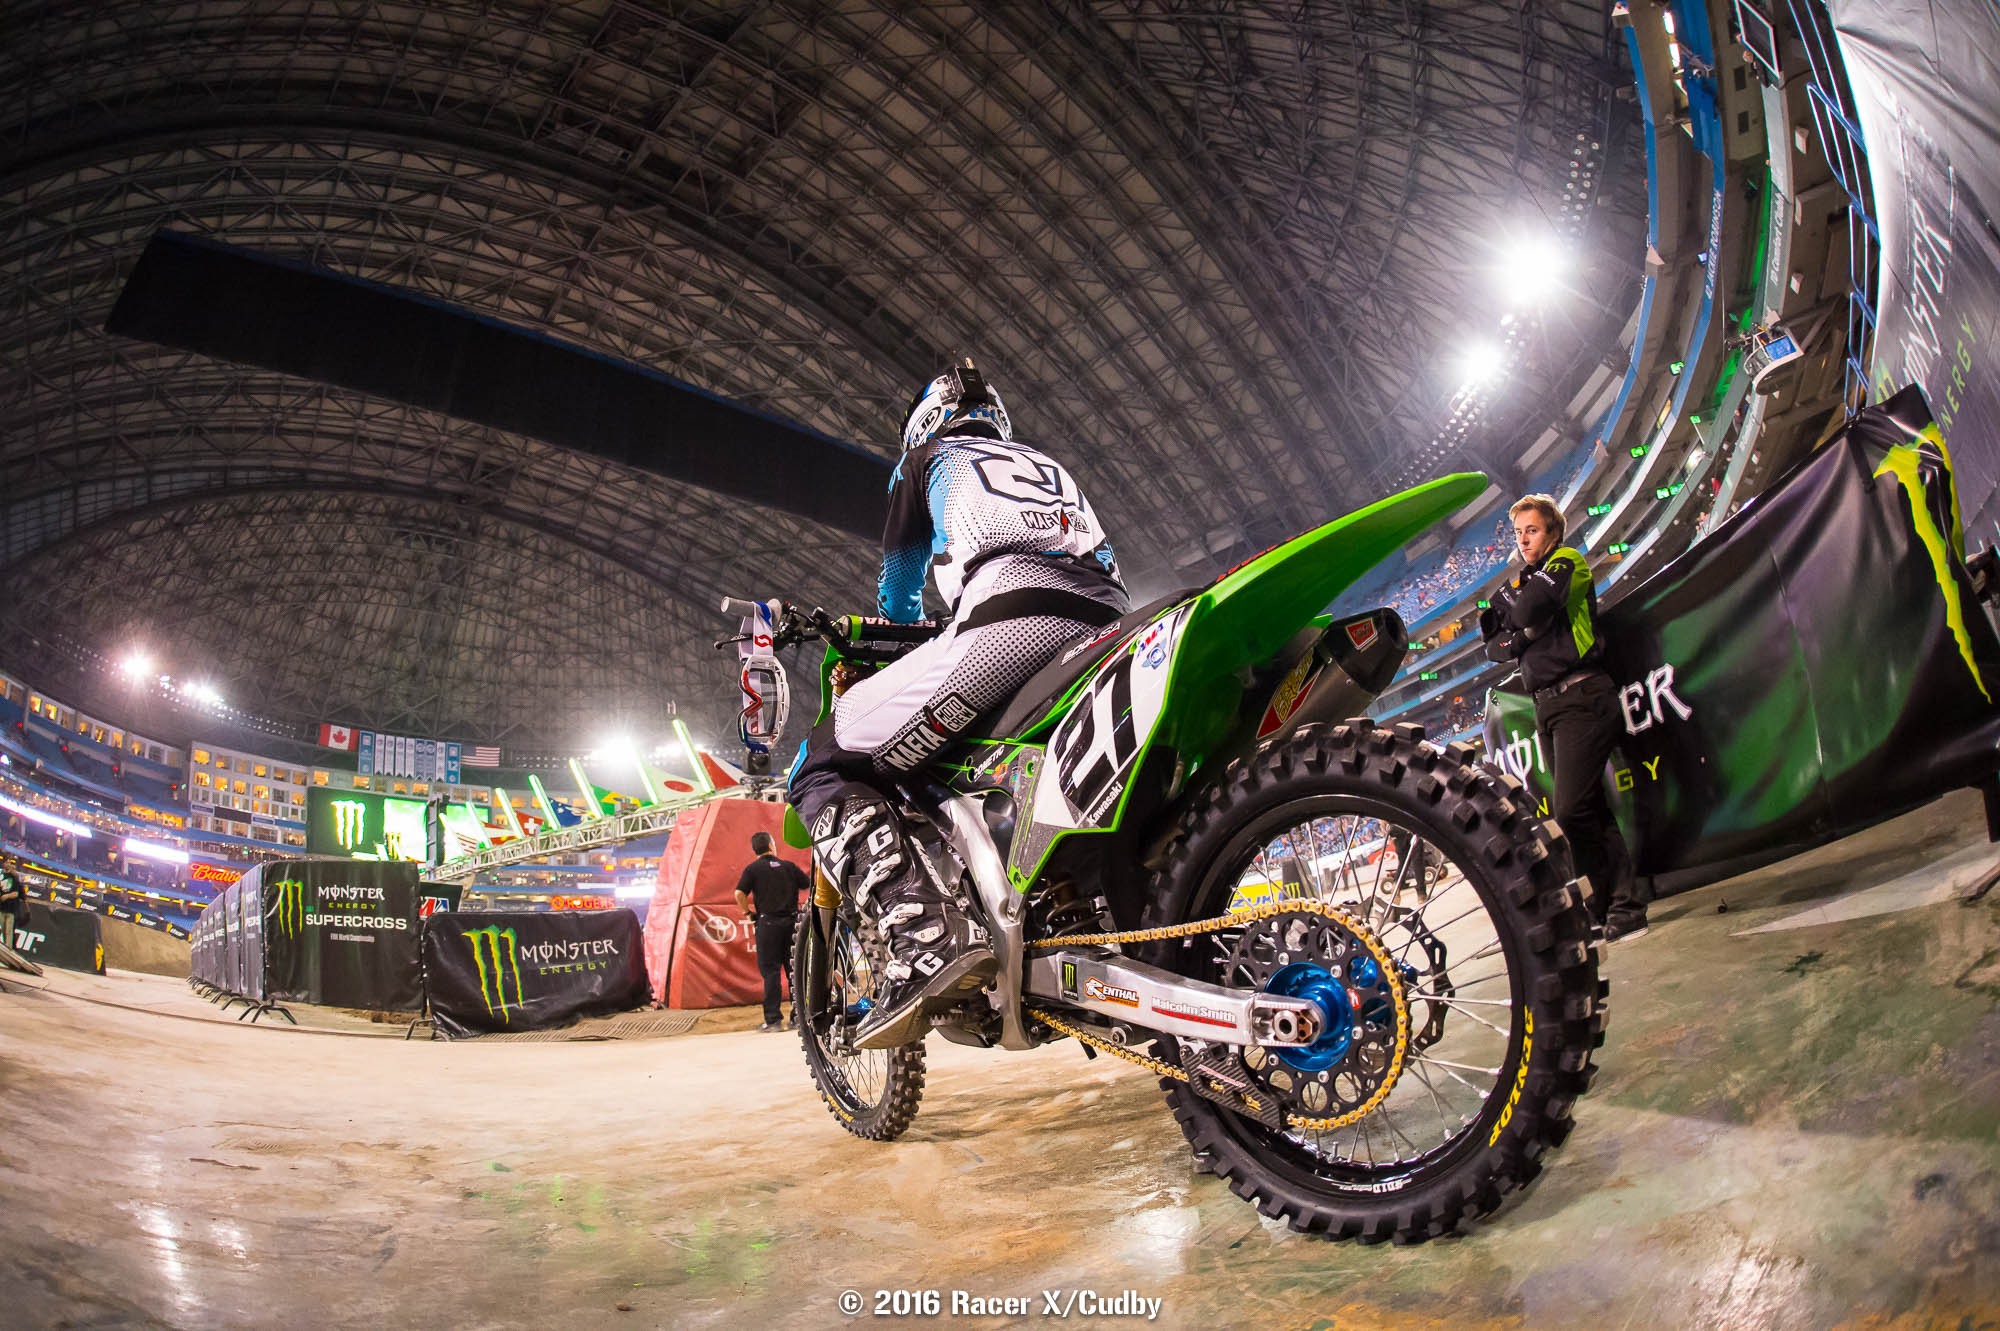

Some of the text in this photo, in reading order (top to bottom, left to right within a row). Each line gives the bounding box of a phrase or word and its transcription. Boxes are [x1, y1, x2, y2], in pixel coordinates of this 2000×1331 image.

[1899, 197, 1953, 404] ONSTER
[1938, 311, 1977, 433] NERGY
[936, 698, 962, 724] MOTO
[947, 708, 974, 732] CREW
[884, 724, 948, 772] MAFIA
[1086, 780, 1124, 826] Kawasaki
[317, 884, 386, 901] MONSTER
[566, 896, 617, 910] ROGERS
[328, 902, 378, 911] ENERGY
[305, 914, 408, 931] SUPERCROSS
[521, 938, 620, 965] MONSTER
[539, 960, 608, 976] ENERGY
[1152, 996, 1198, 1016] Malcolm
[1199, 1005, 1237, 1024] Smith
[1488, 1004, 1535, 1148] DUNLOP
